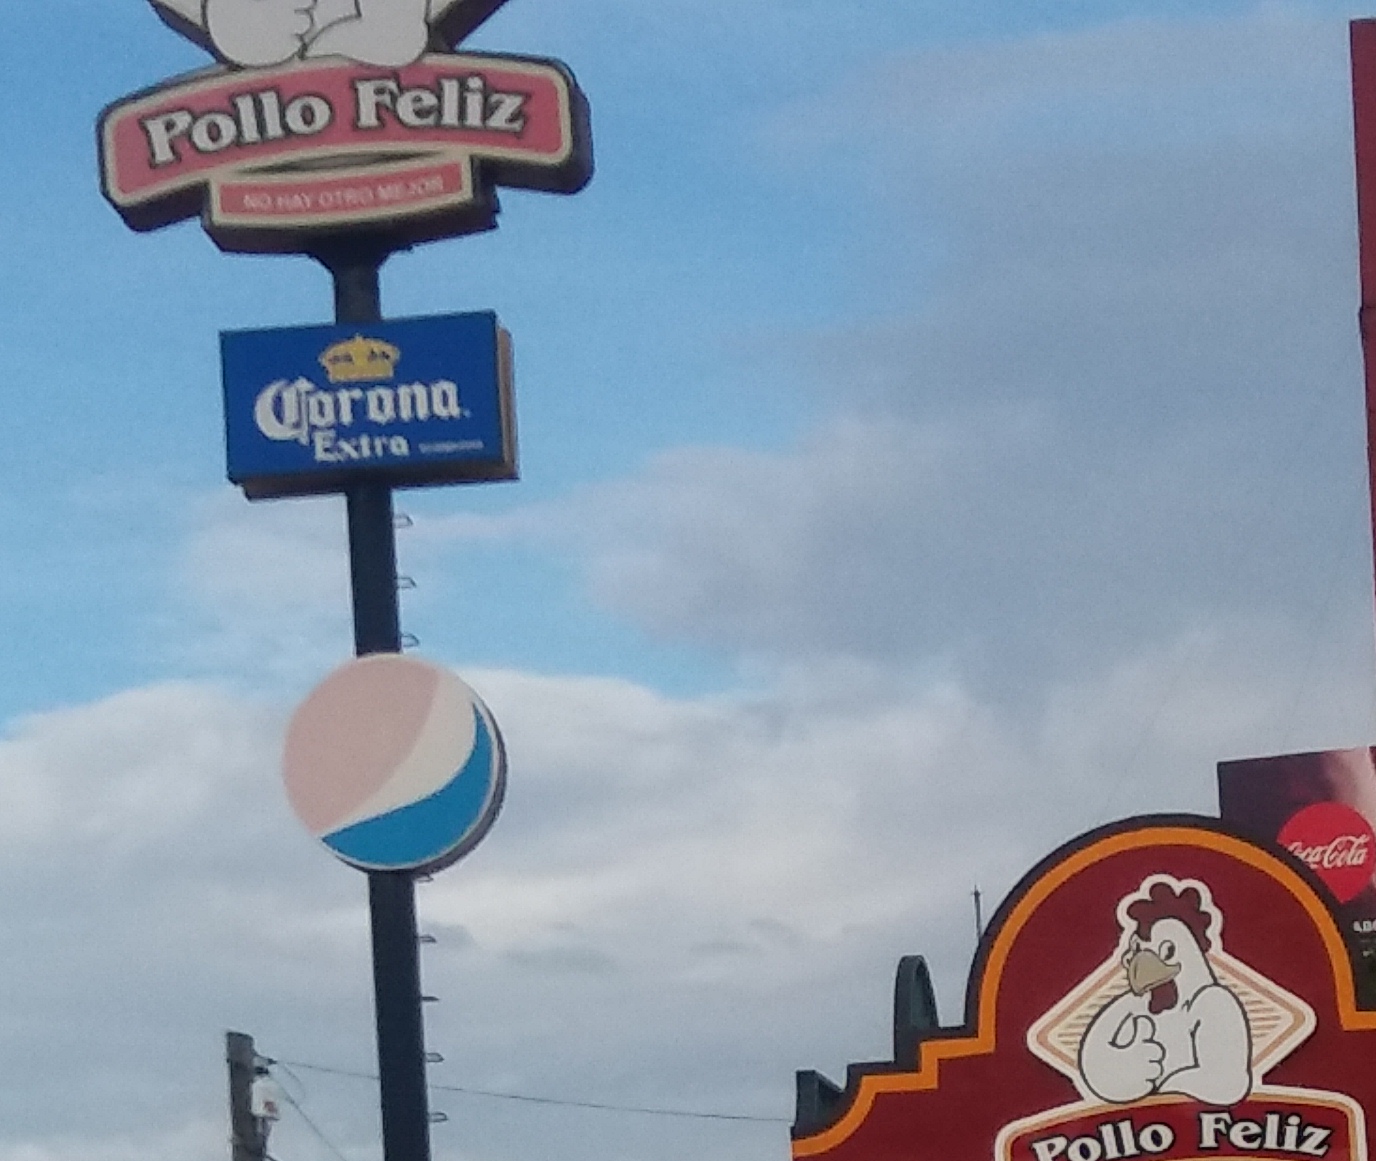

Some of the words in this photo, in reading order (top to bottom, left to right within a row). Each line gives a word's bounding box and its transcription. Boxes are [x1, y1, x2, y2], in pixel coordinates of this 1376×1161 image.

[142, 89, 332, 168] Pollo
[353, 74, 528, 132] Feliz
[253, 376, 462, 446] Corona
[312, 428, 411, 462] Extra
[1197, 1111, 1333, 1158] Feliz
